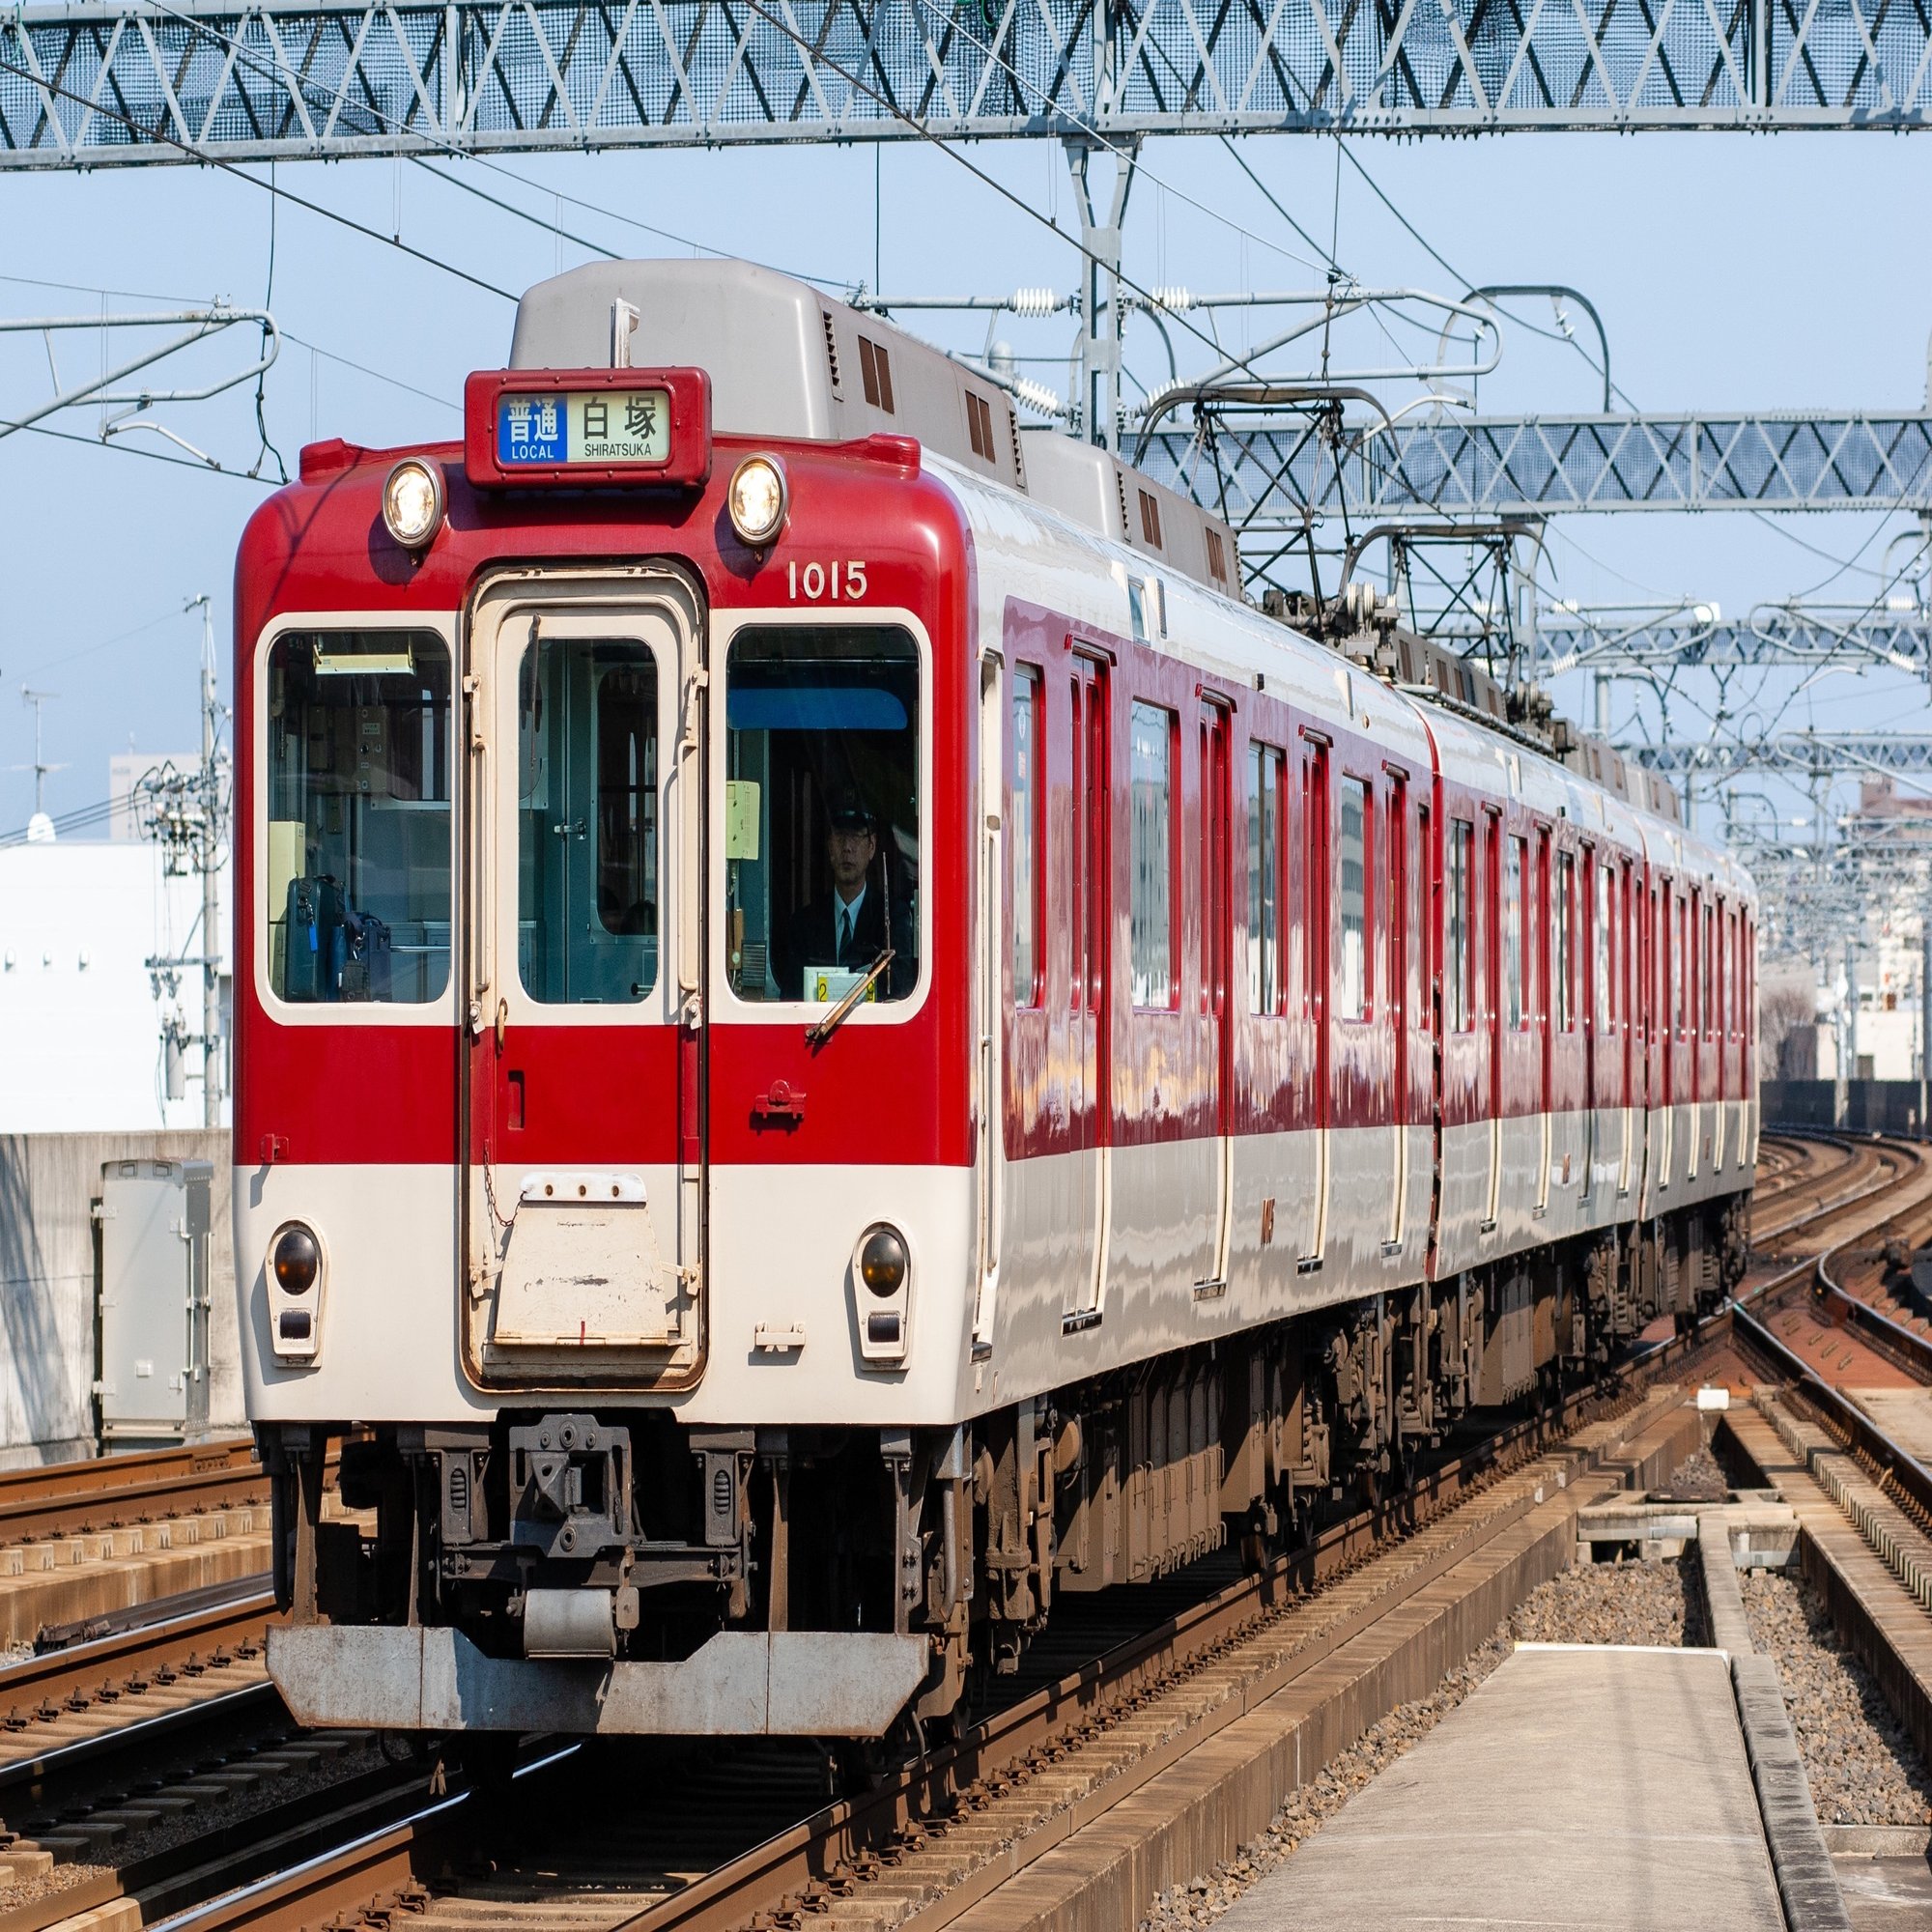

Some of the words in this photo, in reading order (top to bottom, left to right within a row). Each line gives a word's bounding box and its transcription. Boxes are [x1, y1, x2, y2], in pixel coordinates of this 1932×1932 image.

[507, 397, 558, 443] 普通
[583, 396, 657, 440] 白塚
[511, 444, 554, 459] LOCAL
[584, 442, 652, 457] SHIRATSUKA
[789, 560, 867, 599] 1015
[818, 982, 828, 1003] 2
